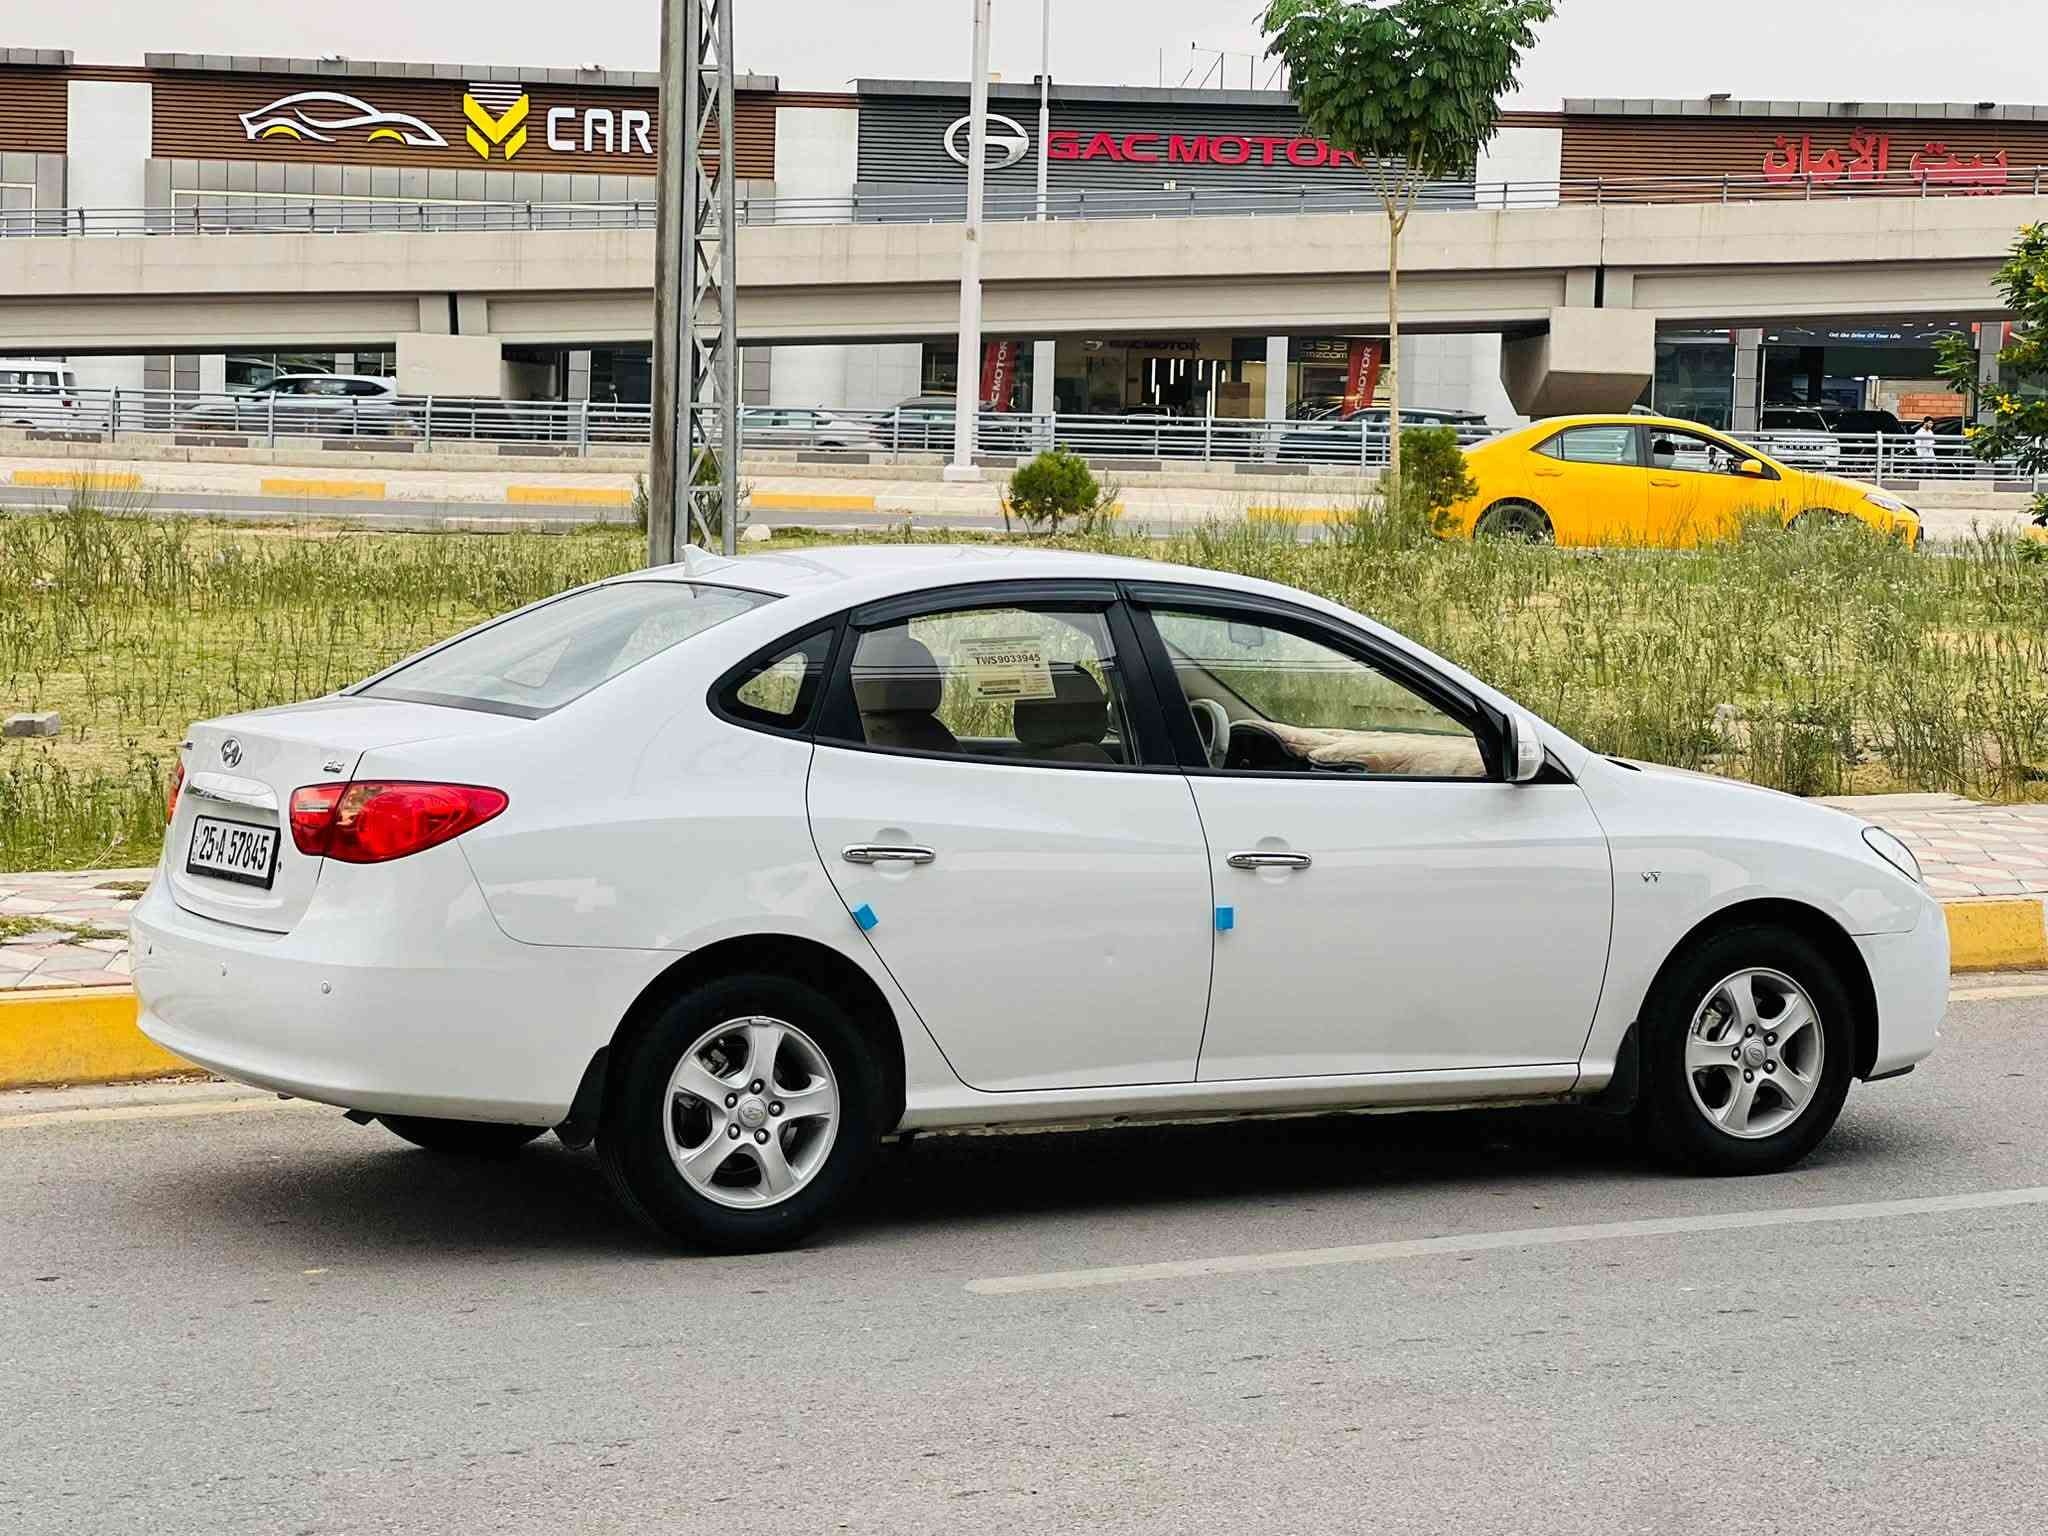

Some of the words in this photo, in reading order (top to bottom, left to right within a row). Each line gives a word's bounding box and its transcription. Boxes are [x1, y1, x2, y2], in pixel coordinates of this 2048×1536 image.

[547, 107, 653, 154] CAR
[1048, 131, 1160, 161] GAC
[228, 830, 270, 871] 57845
